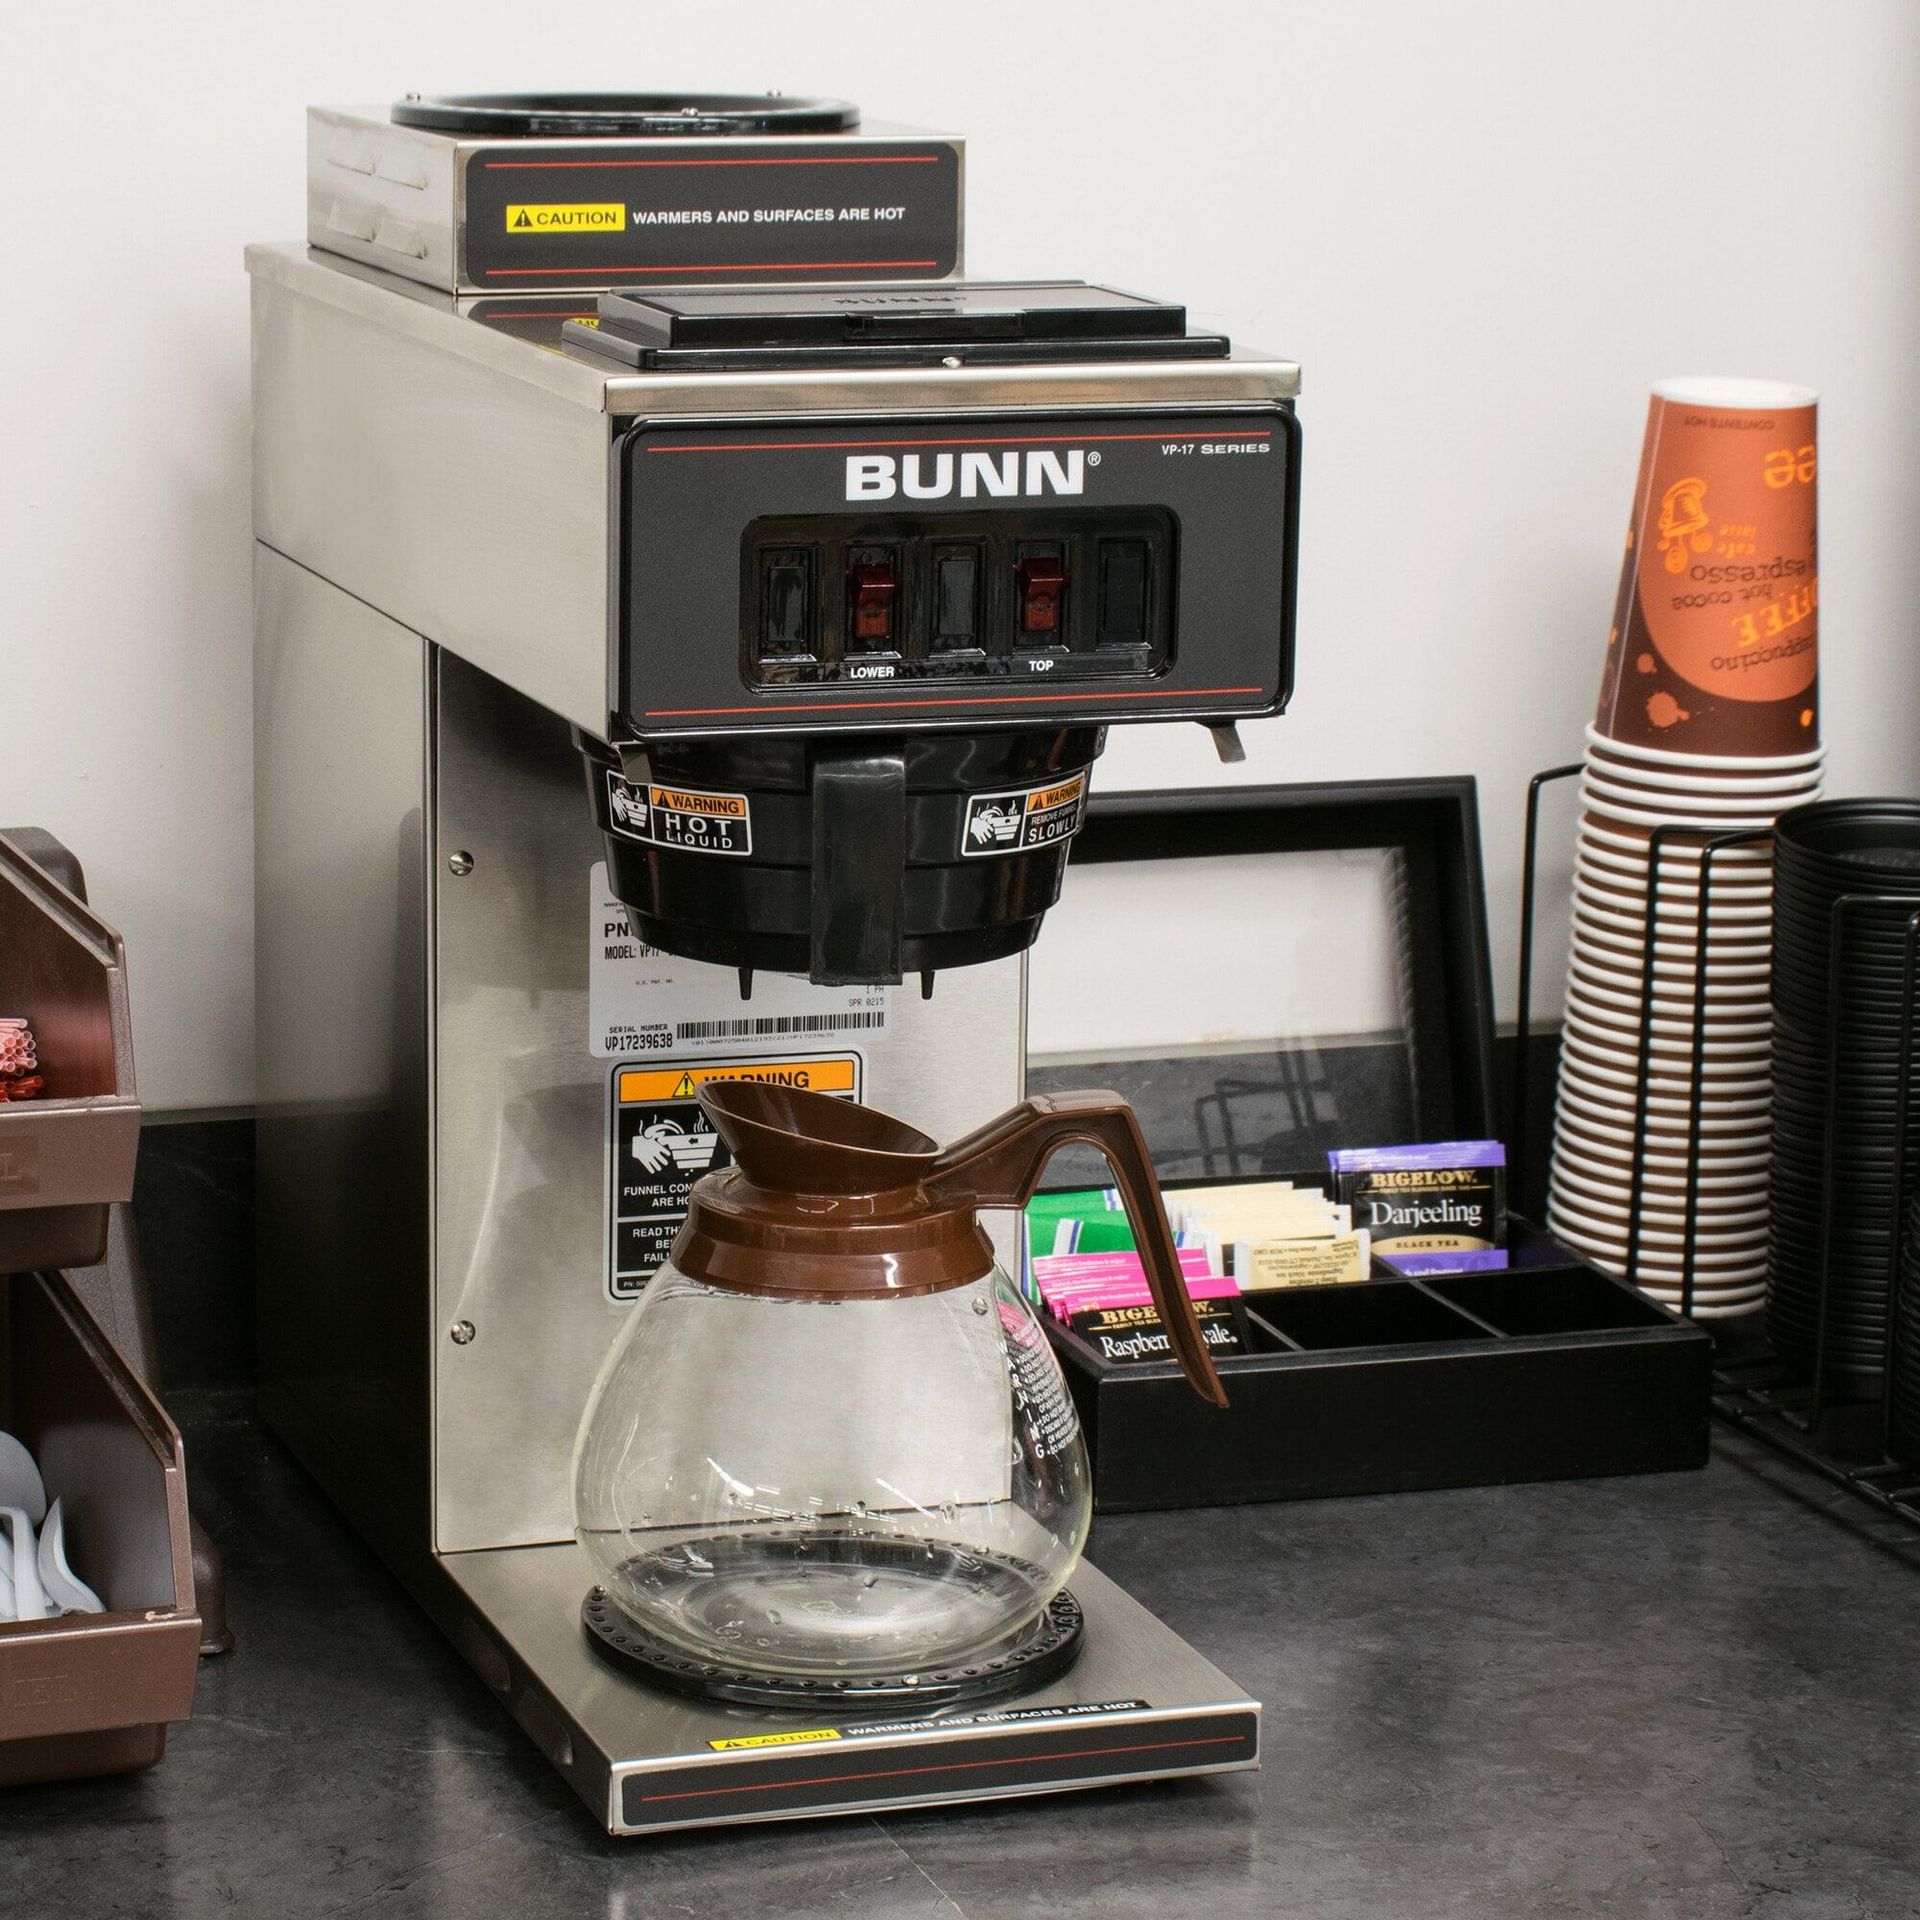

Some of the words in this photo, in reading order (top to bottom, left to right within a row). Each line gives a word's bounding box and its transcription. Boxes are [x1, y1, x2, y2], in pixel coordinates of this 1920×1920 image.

[536, 211, 617, 225] CAUTION
[632, 211, 712, 225] WARMERS
[716, 210, 750, 223] AND
[753, 208, 834, 223] SURFACES
[838, 207, 870, 221] ARE
[874, 207, 906, 220] HOT
[1161, 444, 1195, 456] VP-17
[1200, 443, 1271, 455] SERIES
[1690, 556, 1807, 584] espresso
[1672, 591, 1733, 610] cocoa
[850, 666, 895, 679] LOWER
[1028, 660, 1054, 672] TOP
[1046, 781, 1081, 805] WARNING
[671, 793, 740, 815] WARNING
[665, 812, 732, 836] HOT
[1028, 813, 1076, 843] SLOWLY
[666, 830, 733, 849] LIQUID
[609, 1025, 637, 1034] SERIAL
[640, 1023, 669, 1032] NUMBER
[605, 1032, 673, 1052] VP17239638
[623, 1185, 667, 1197] FUNNEL
[651, 1197, 674, 1208] ARE
[1369, 1199, 1483, 1228] Darjeeling
[632, 1227, 663, 1238] READ
[1395, 1240, 1433, 1249] BLACK
[1437, 1239, 1460, 1247] TEA
[1099, 1332, 1171, 1359] Raspberr
[746, 1732, 833, 1745] CAUTION
[847, 1721, 935, 1736] WARMERS
[939, 1717, 974, 1728] AND
[975, 1708, 1063, 1723] SURFACES
[1067, 1704, 1103, 1715] ARE
[1103, 1701, 1138, 1711] HOT
